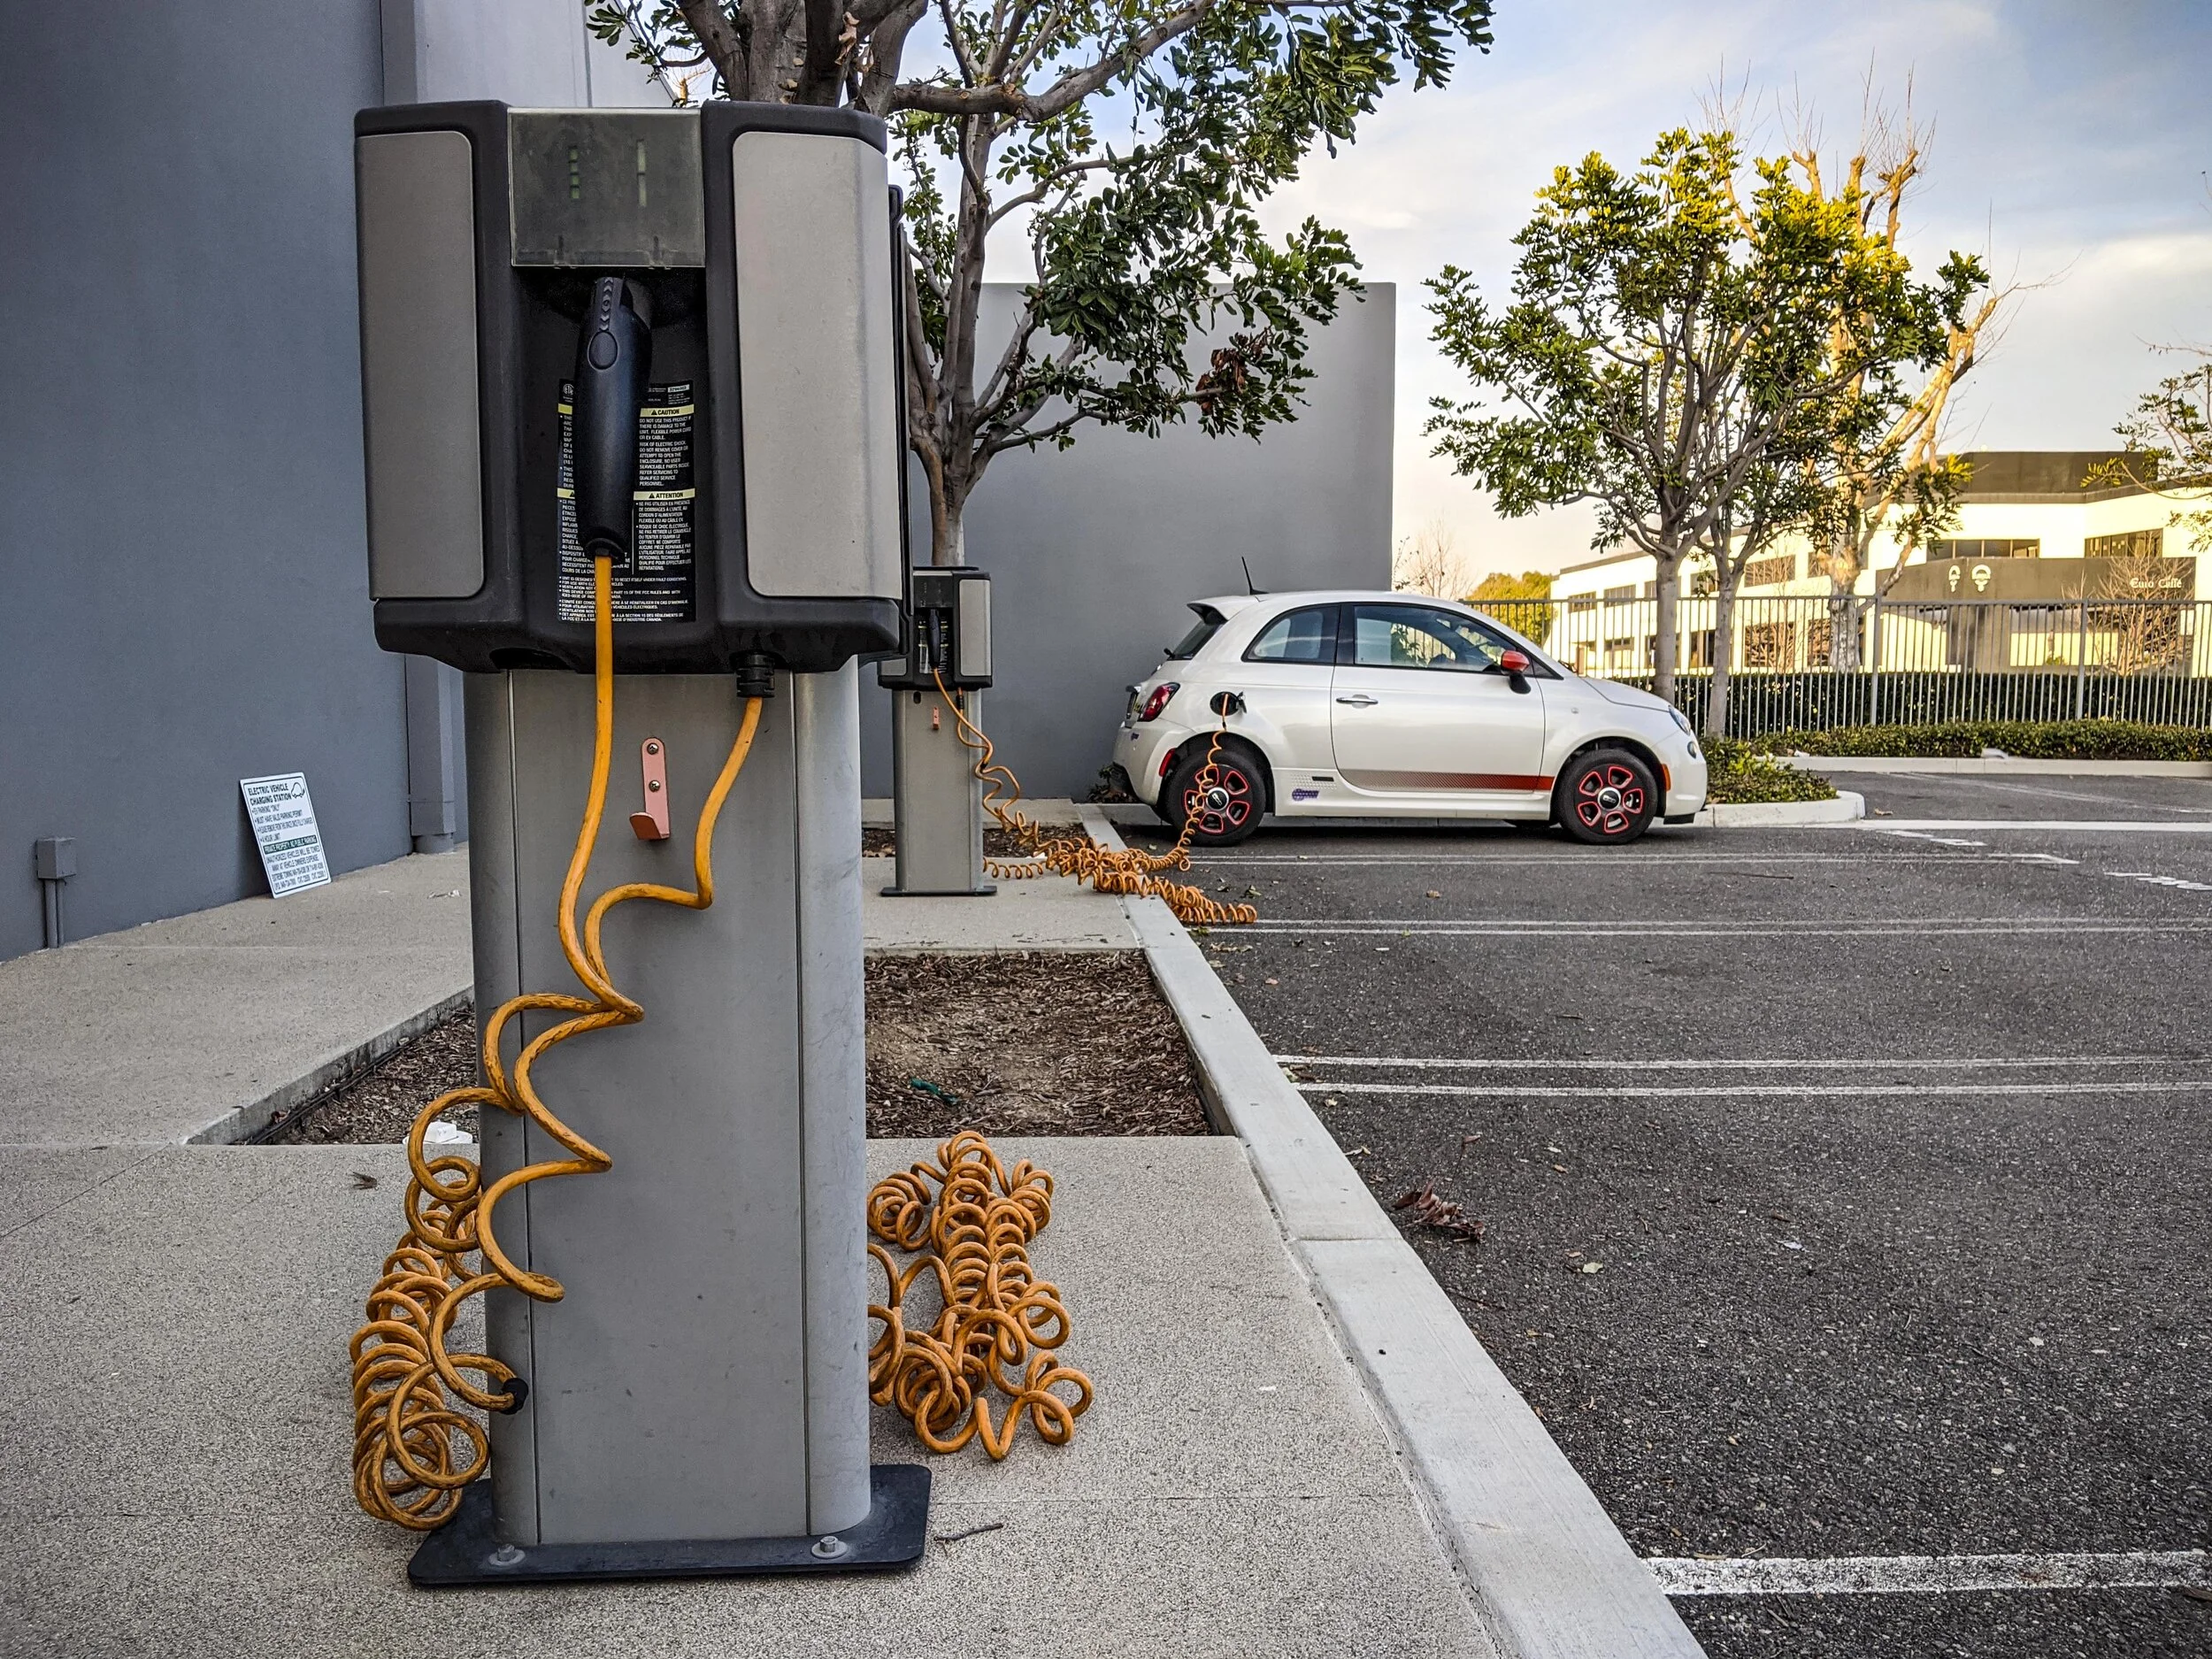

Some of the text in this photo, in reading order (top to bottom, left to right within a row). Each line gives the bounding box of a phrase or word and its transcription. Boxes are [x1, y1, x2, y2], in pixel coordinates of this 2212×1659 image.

[247, 782, 288, 795] ELECTRIC VEHICLE
[249, 792, 291, 805] CHARGING STATION
